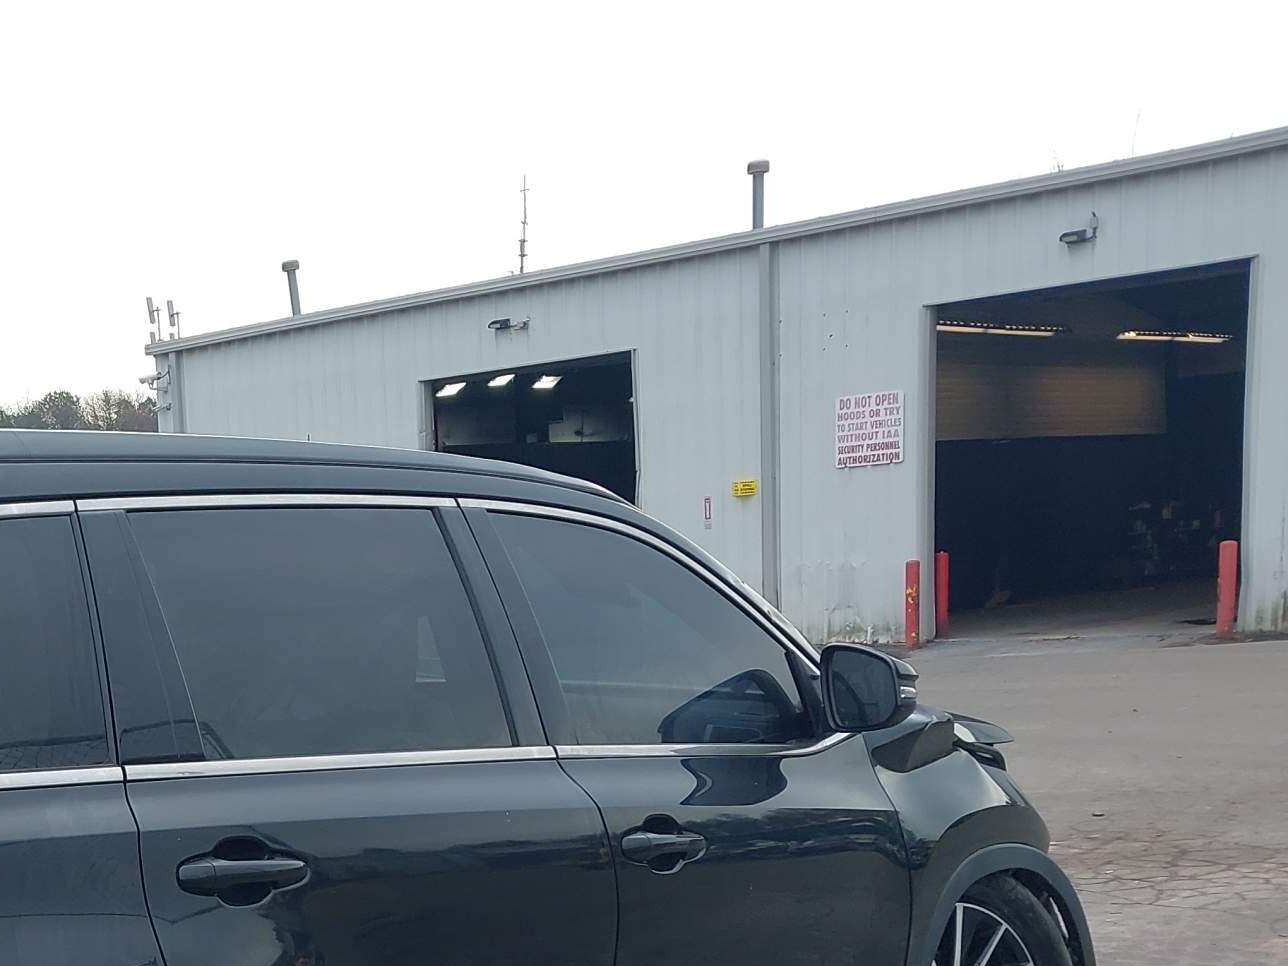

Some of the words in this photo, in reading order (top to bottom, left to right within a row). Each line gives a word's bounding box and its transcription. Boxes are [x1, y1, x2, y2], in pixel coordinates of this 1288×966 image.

[839, 398, 851, 411] DO
[874, 392, 899, 407] OPEN
[869, 408, 881, 418] OR
[884, 405, 901, 416] TRY
[837, 423, 846, 433] TO
[847, 421, 868, 433] START
[870, 418, 902, 430] VEHICLES
[837, 431, 879, 443] WITHOUT
[882, 428, 900, 438] IAA
[837, 444, 865, 455] SECURITY
[837, 452, 900, 466] AUTHORIZATION
